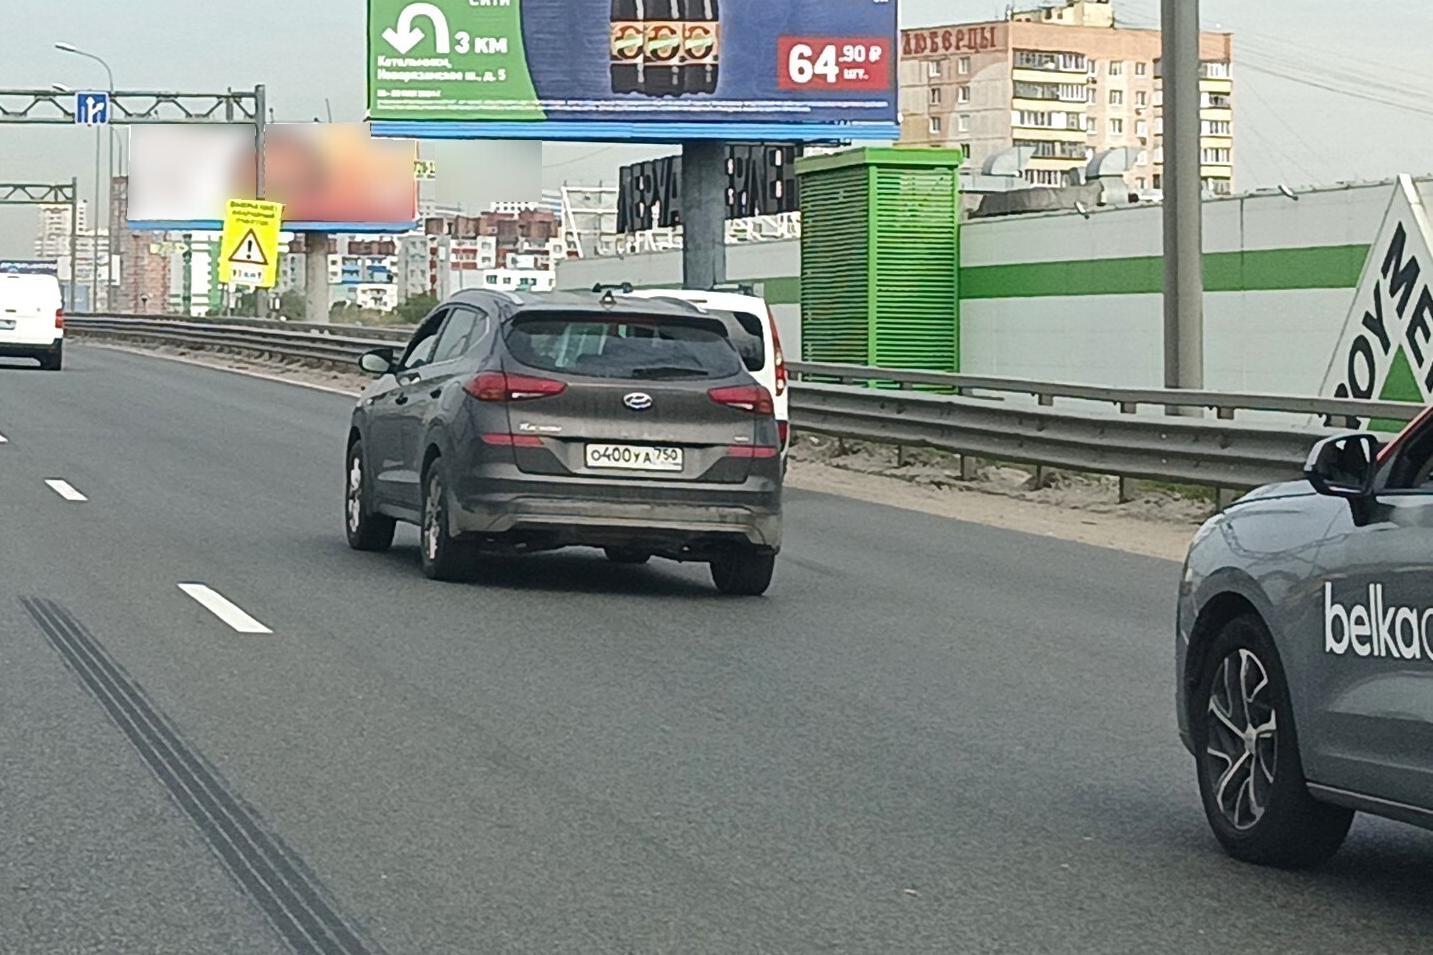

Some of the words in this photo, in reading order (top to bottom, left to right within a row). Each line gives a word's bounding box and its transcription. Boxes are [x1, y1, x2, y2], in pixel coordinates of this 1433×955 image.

[454, 31, 470, 53] 3
[902, 26, 997, 55] ЛЮБЕРЦЫ
[788, 44, 839, 83] 64
